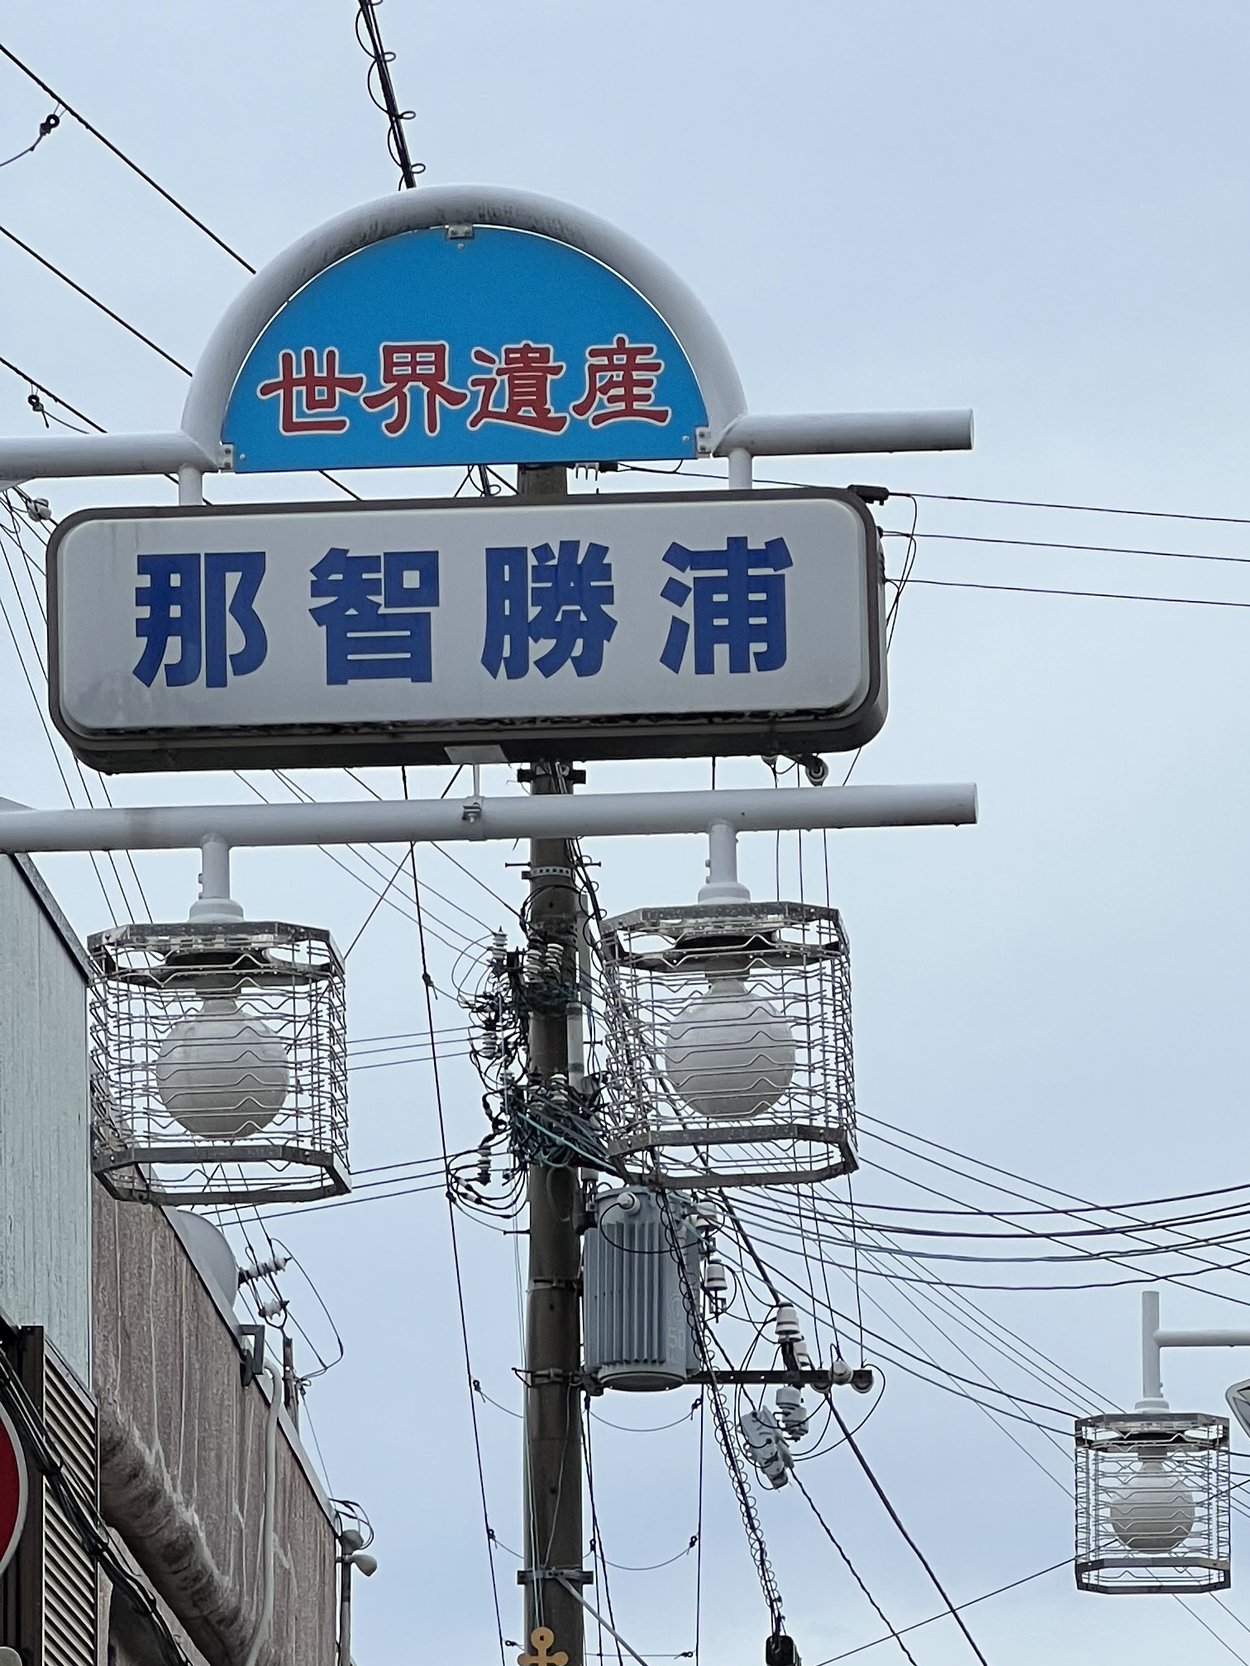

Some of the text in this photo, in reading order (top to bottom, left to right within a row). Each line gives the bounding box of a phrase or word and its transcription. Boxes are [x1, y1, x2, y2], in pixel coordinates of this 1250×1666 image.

[257, 334, 672, 439] 世界遺産
[132, 536, 794, 689] 那智勝浦
